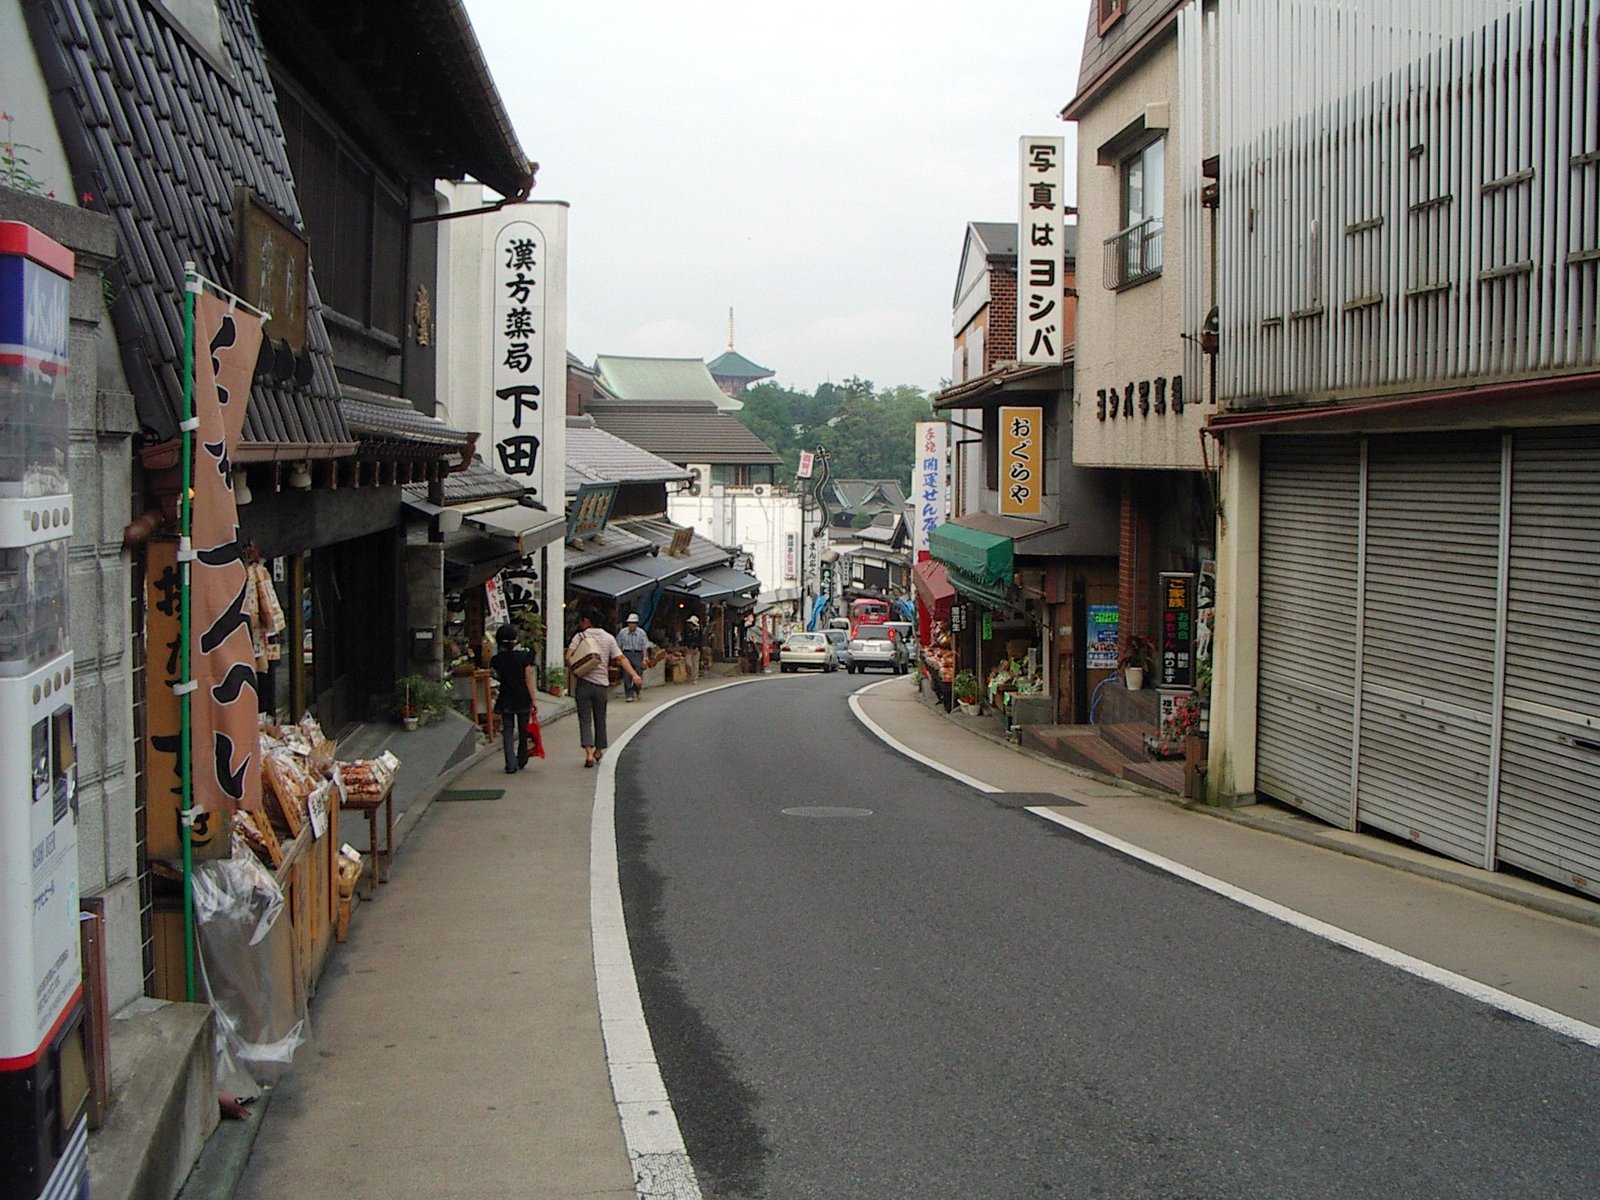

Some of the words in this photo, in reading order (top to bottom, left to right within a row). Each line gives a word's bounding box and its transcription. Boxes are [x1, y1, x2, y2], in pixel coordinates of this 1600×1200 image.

[504, 237, 537, 373] 漢方薬局
[1028, 144, 1057, 357] 写真はヨシバ
[1010, 417, 1031, 505] おぐらや
